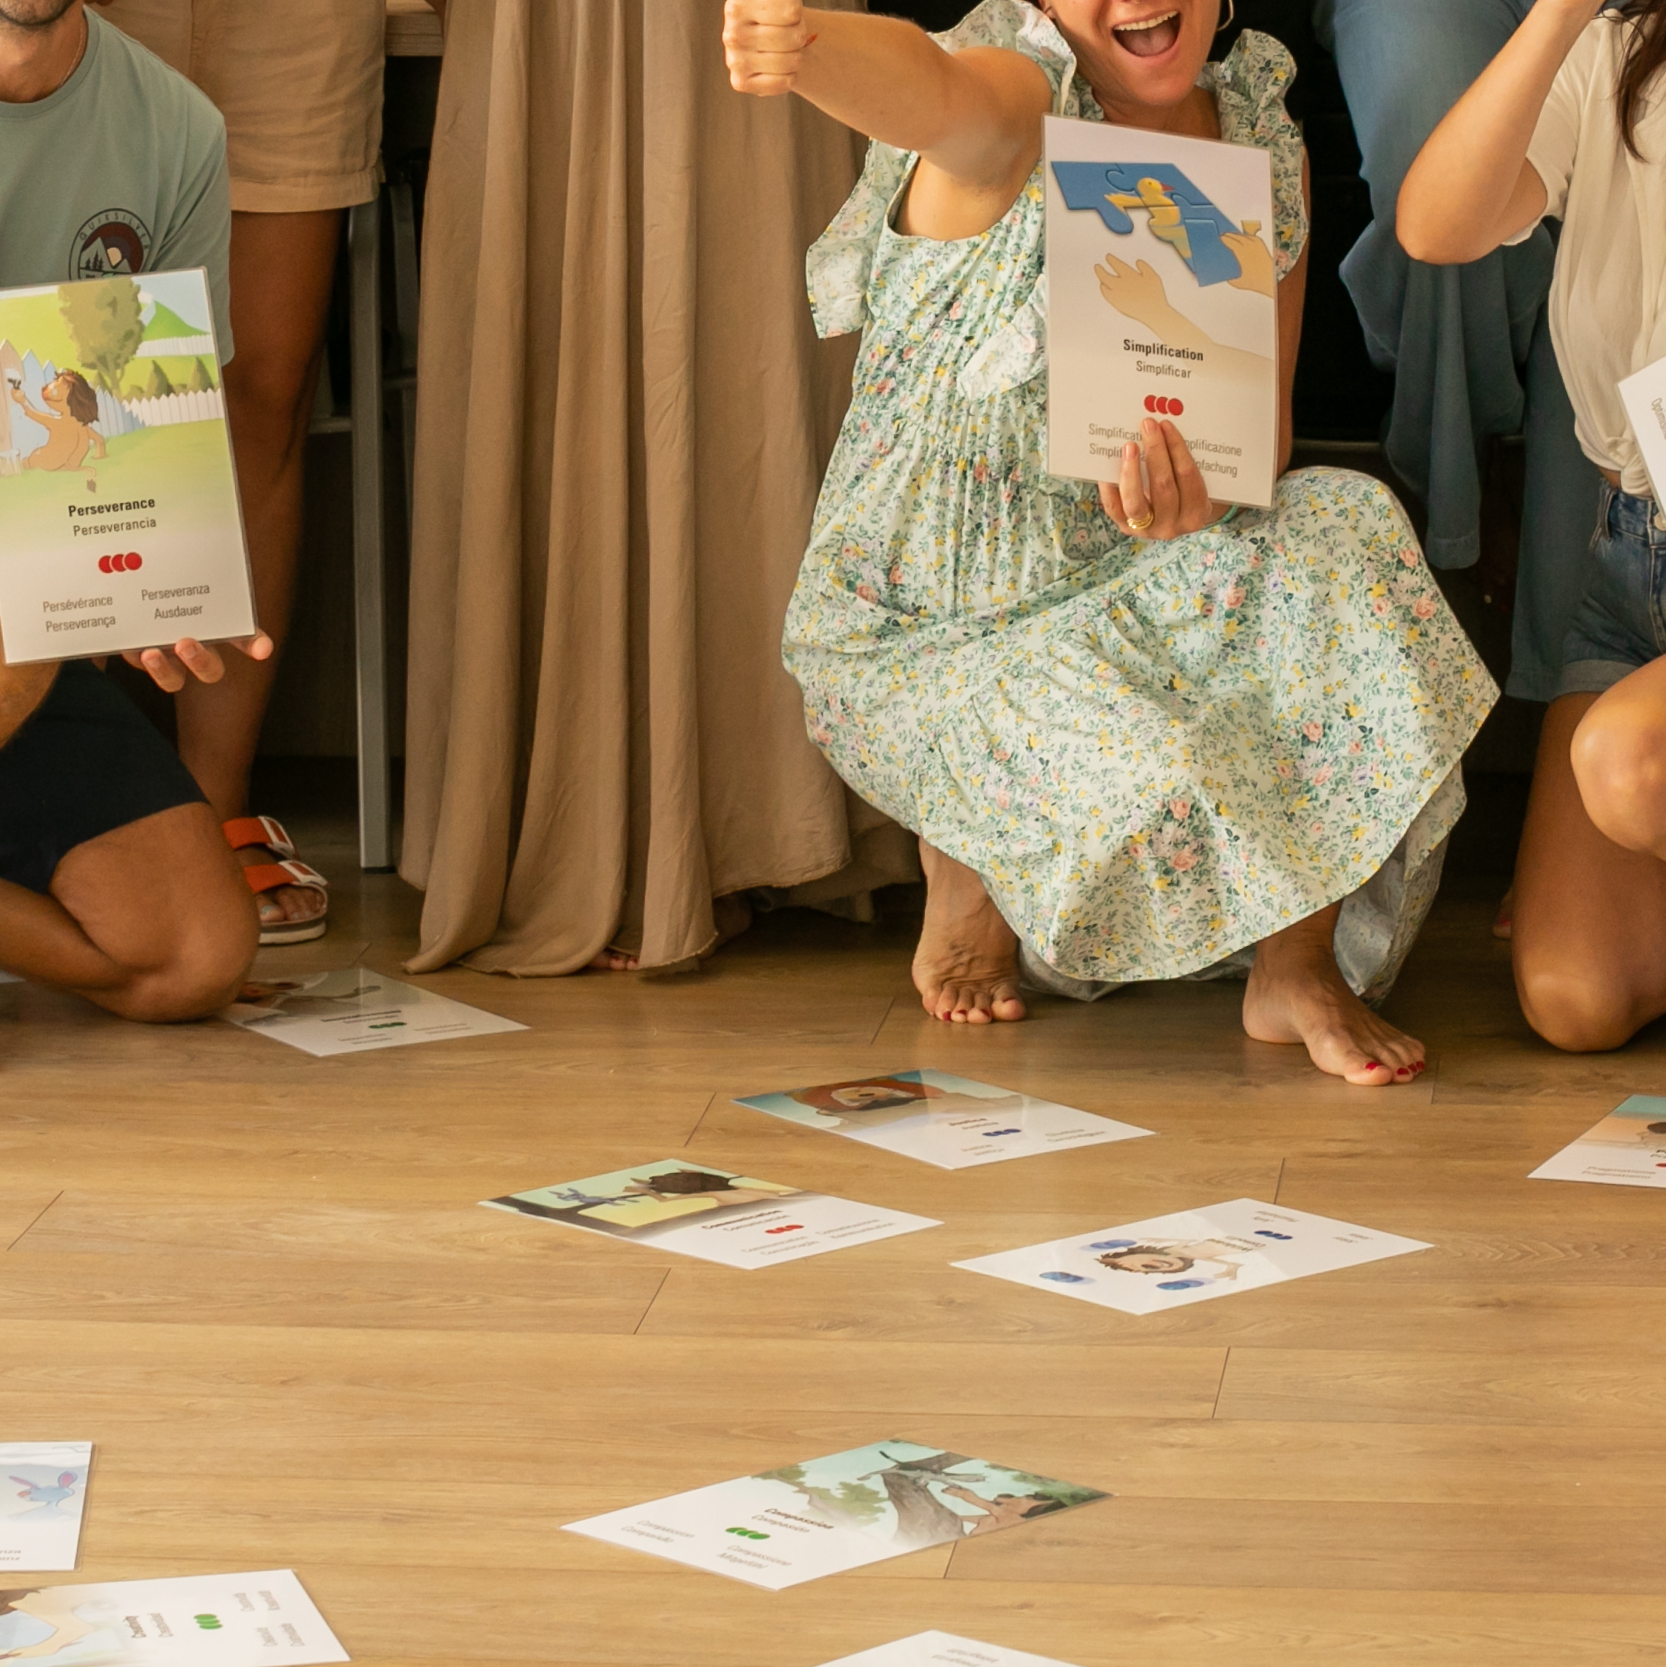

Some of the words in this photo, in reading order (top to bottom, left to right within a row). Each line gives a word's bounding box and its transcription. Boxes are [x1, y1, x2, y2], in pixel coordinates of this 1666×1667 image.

[1122, 338, 1204, 362] Simplification
[1135, 360, 1192, 379] Simplificar
[67, 497, 156, 518] Perseverance
[73, 516, 157, 537] Perseverancia
[141, 583, 210, 602] Perseveranza
[42, 595, 114, 614] Persévérance
[154, 603, 204, 620] Ausdauer
[45, 614, 116, 633] Perseverança
